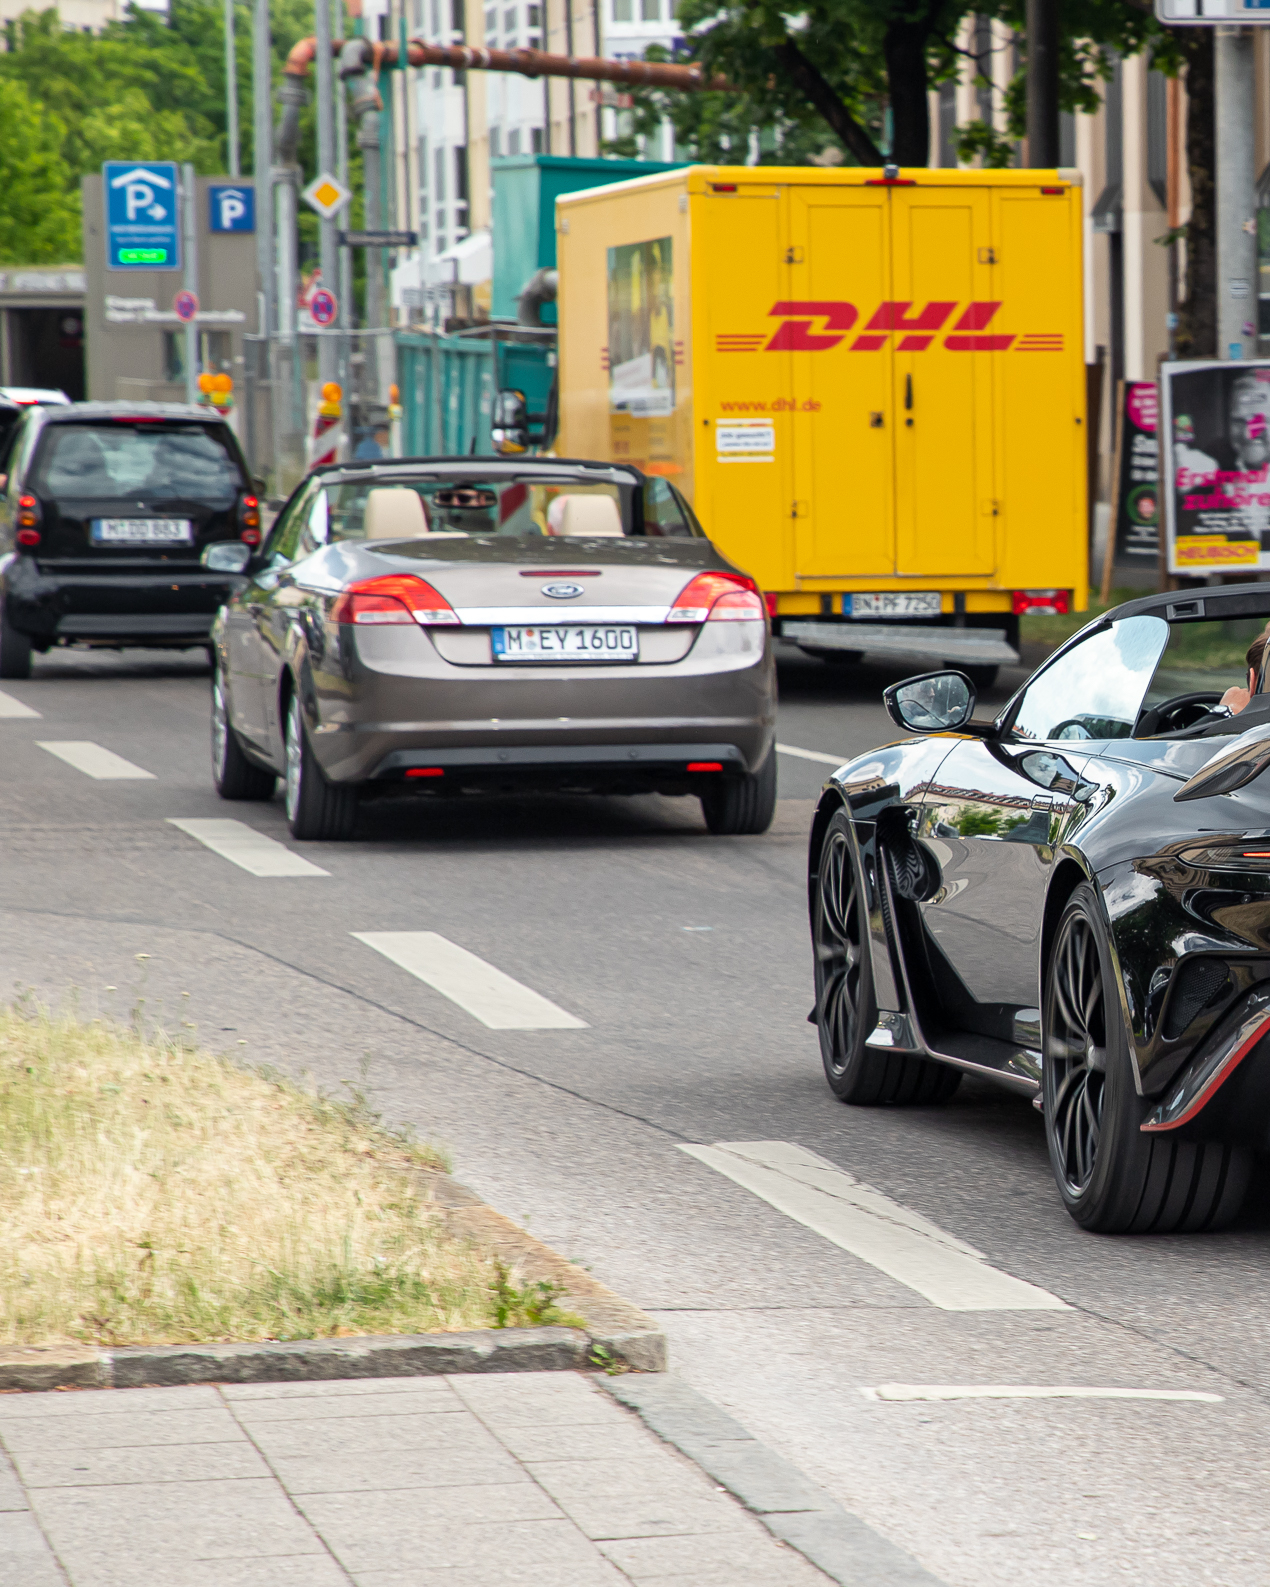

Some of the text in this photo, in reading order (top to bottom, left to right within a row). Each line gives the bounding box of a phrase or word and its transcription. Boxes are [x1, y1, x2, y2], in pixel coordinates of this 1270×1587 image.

[126, 183, 155, 221] P
[764, 301, 1018, 351] DHL
[720, 397, 821, 412] www.dhl.de
[1176, 462, 1270, 487] Erstmal
[507, 629, 633, 650] M EY 1600
